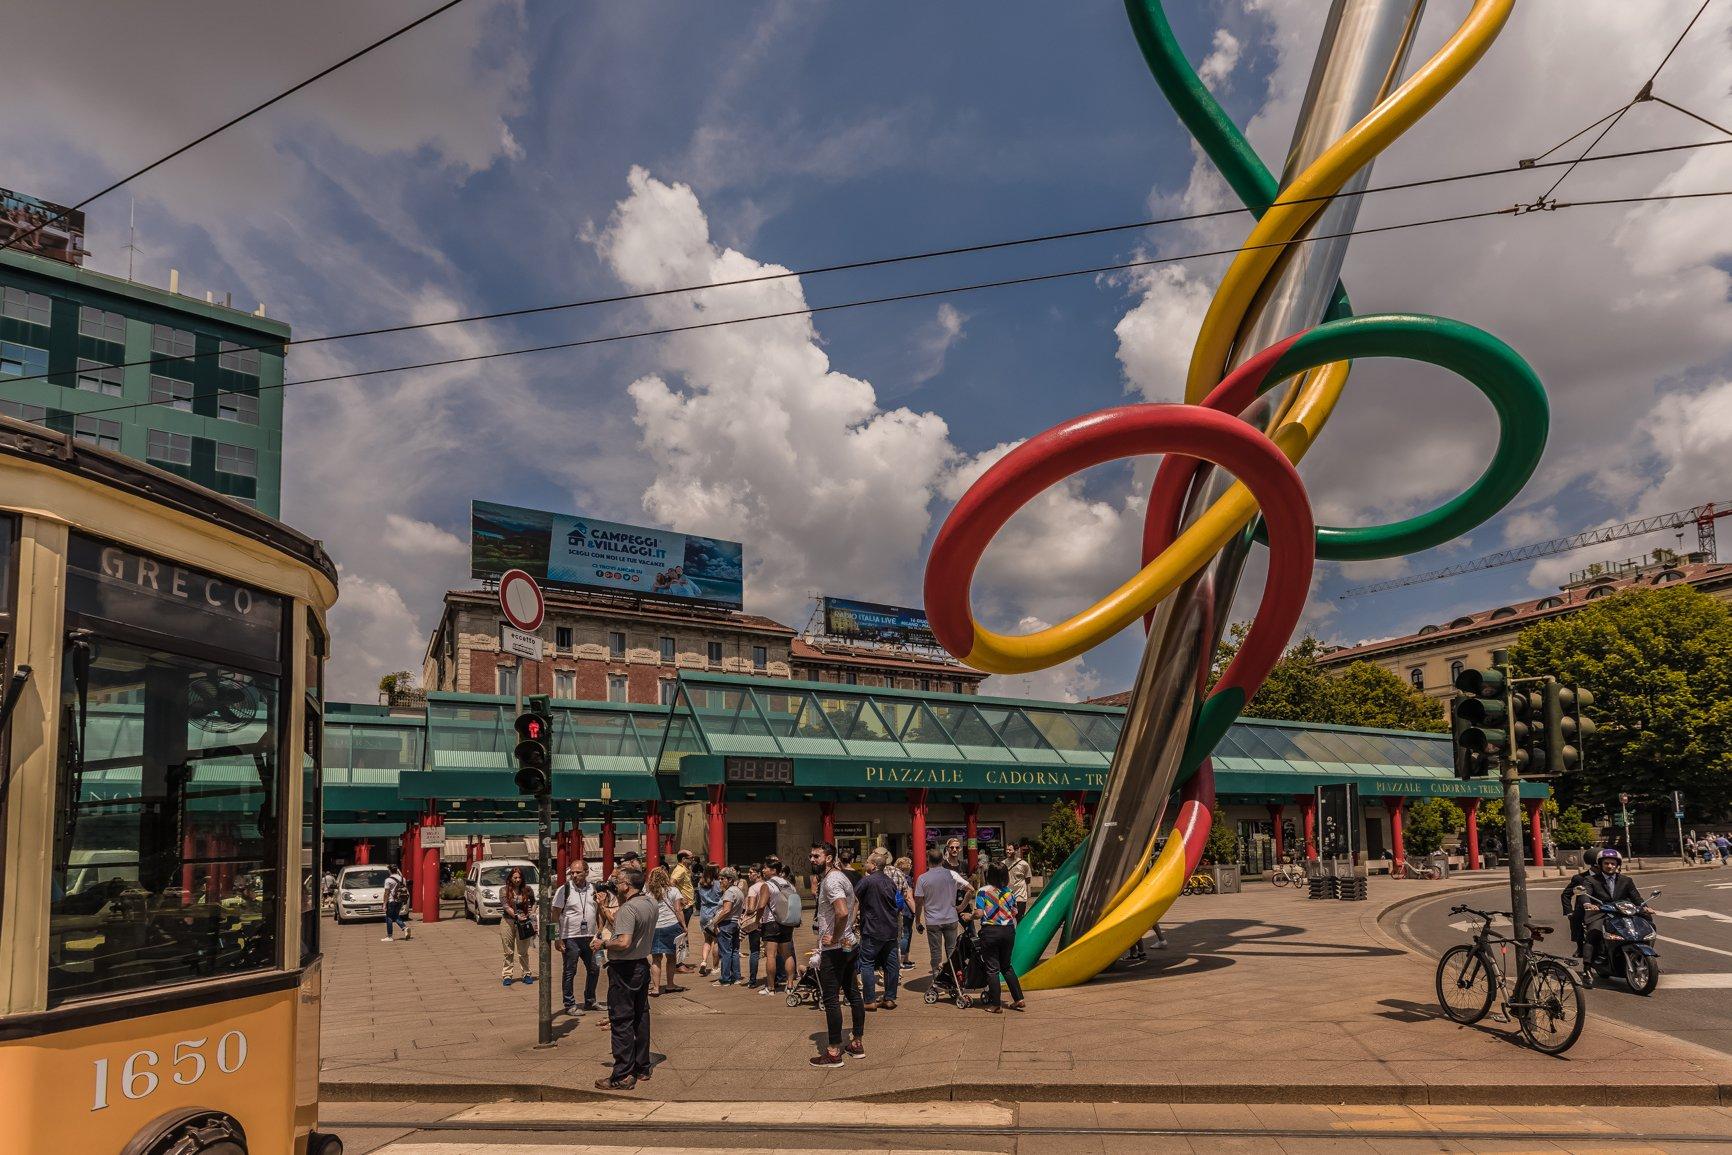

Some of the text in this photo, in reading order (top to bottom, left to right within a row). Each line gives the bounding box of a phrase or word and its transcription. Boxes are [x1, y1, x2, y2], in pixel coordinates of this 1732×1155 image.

[591, 529, 658, 548] CAMPEGGI
[568, 549, 590, 557] SCEGLI
[638, 559, 665, 567] VACANZE
[587, 540, 667, 559] &VILLAGGI.IT
[102, 547, 252, 614] GRECO
[834, 610, 858, 620] RADIO
[858, 612, 880, 623] ITALIA
[881, 616, 897, 625] LIVE
[866, 766, 964, 784] PIAZZALE
[986, 770, 1071, 785] CADORNA
[1376, 781, 1422, 792] PIAZZALE
[1430, 783, 1472, 794] CADORNA
[91, 1030, 249, 1112] 1650
